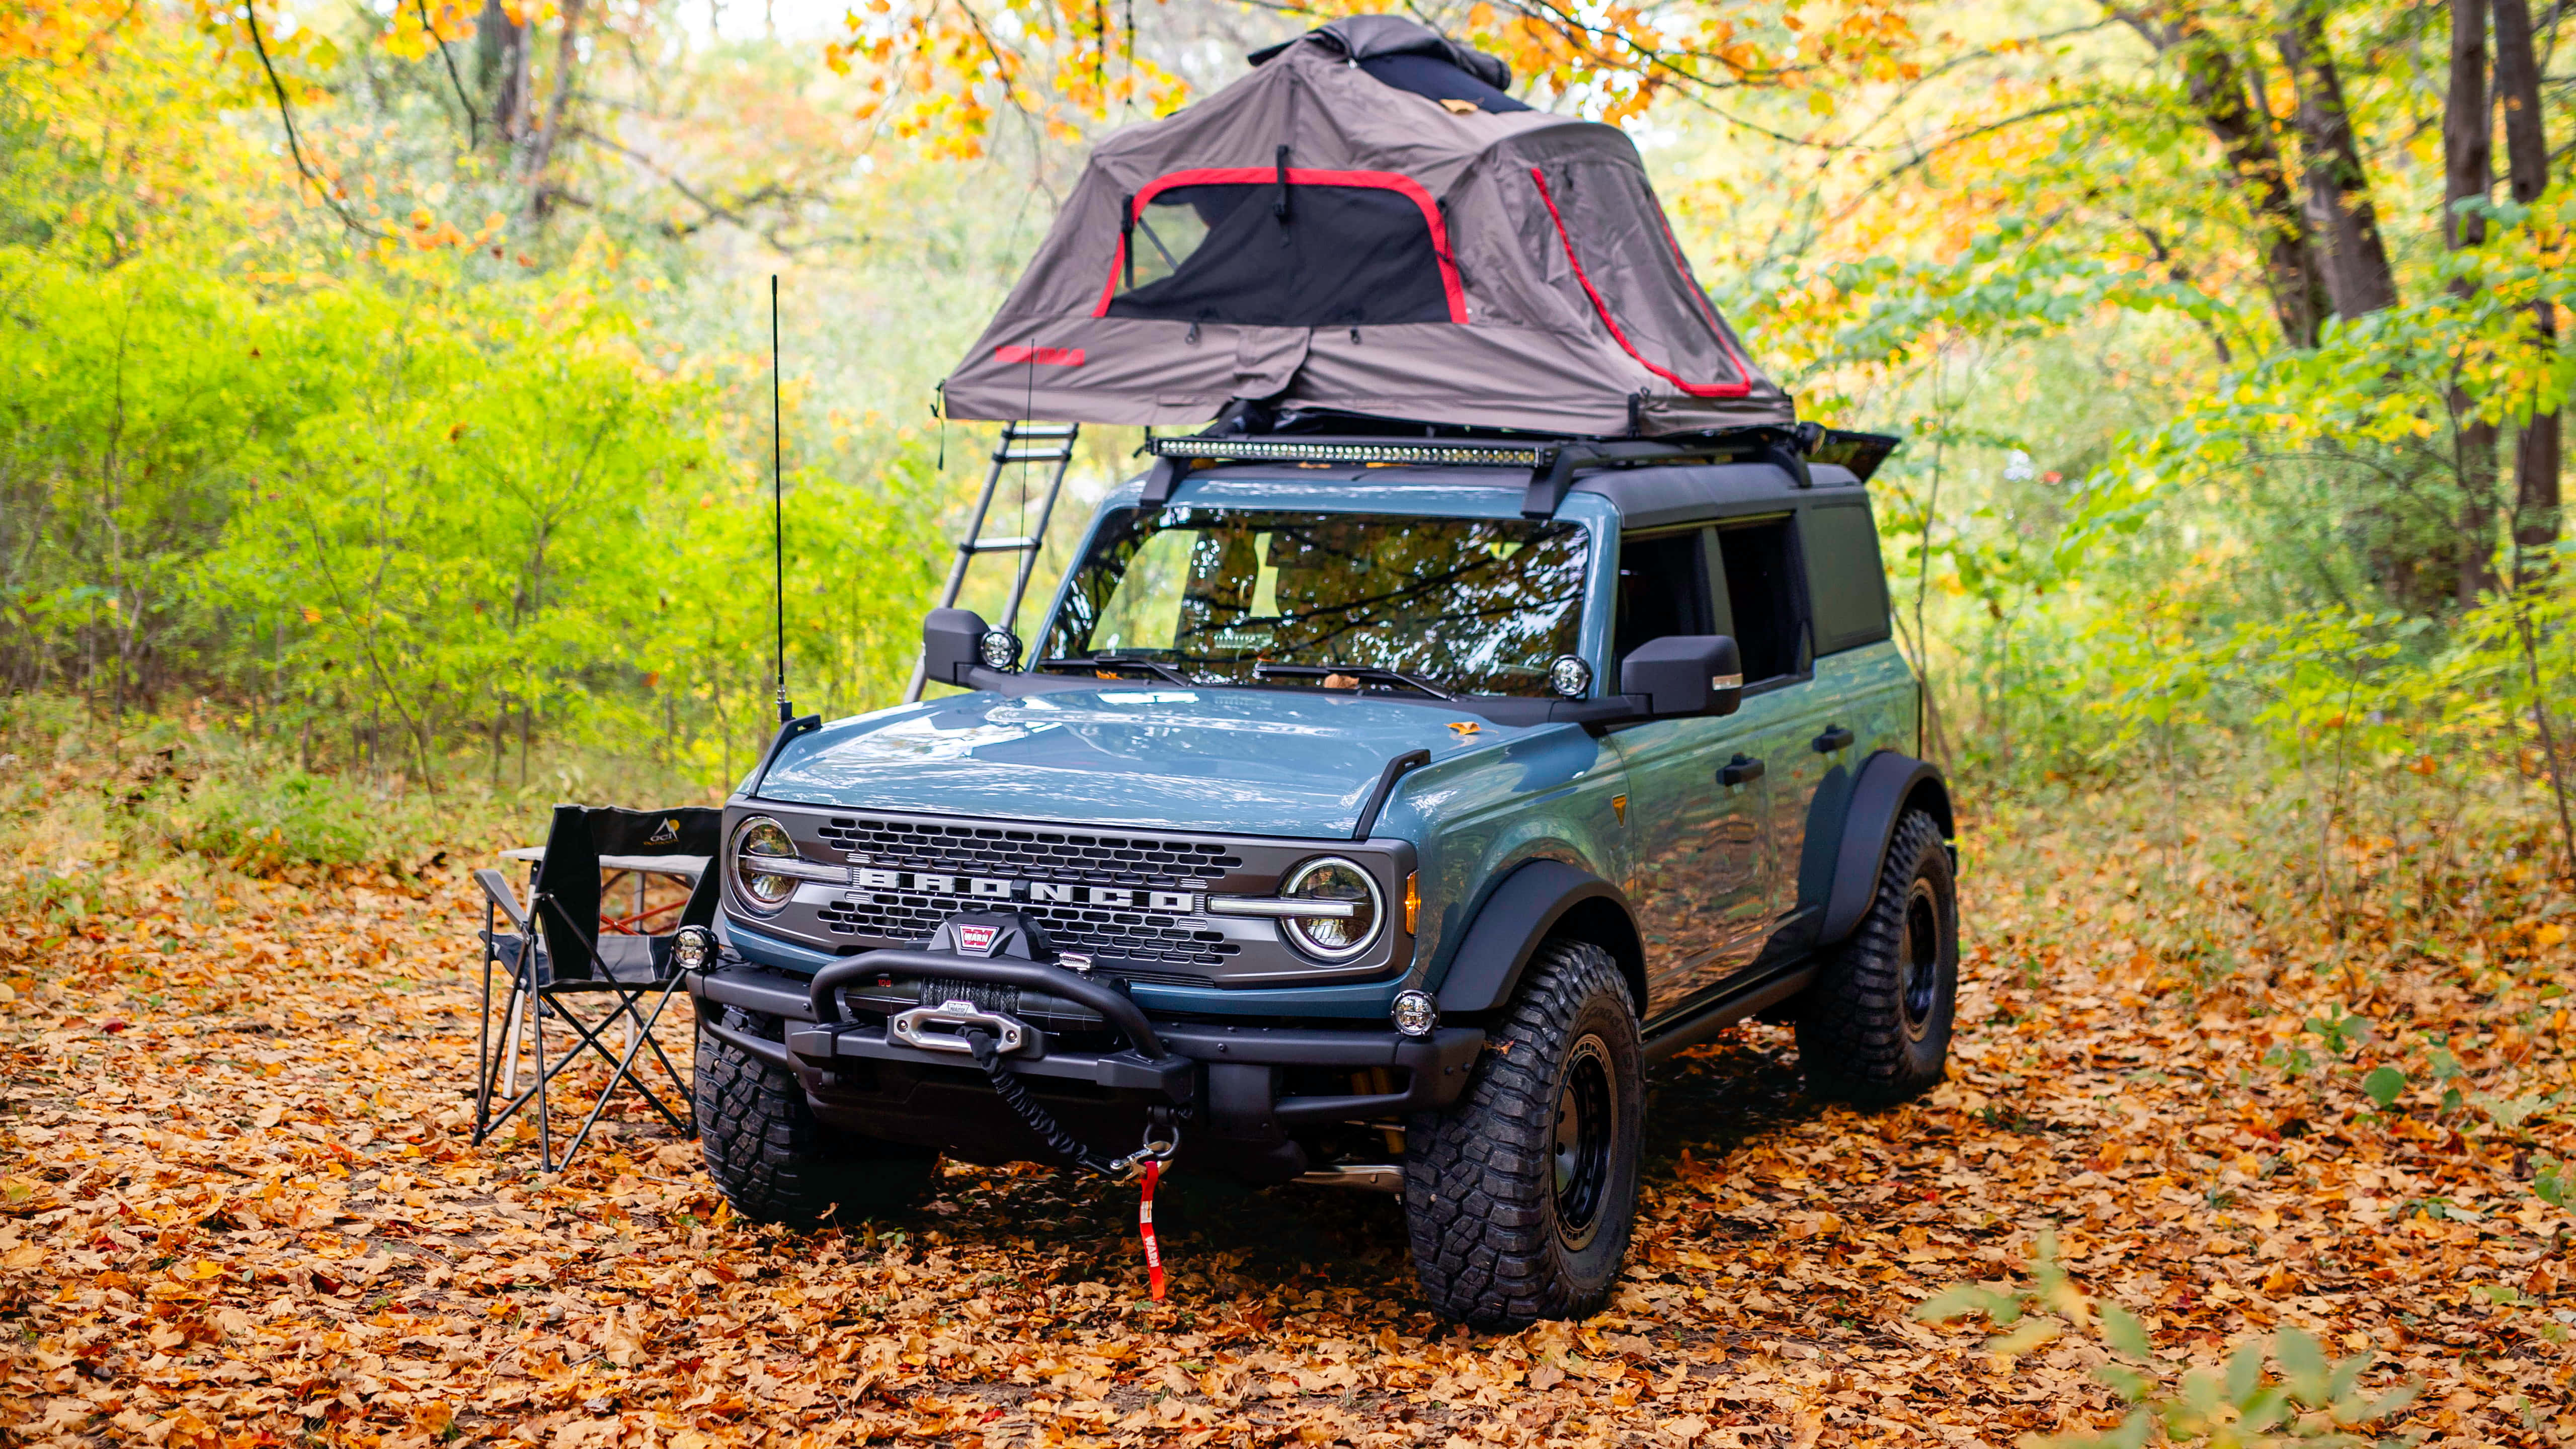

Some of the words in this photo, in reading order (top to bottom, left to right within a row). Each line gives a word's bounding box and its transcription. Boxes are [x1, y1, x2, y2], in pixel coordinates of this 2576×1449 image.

[859, 868, 1193, 912] BRONCO
[964, 932, 989, 942] WARN
[1145, 1235, 1160, 1267] WARN
